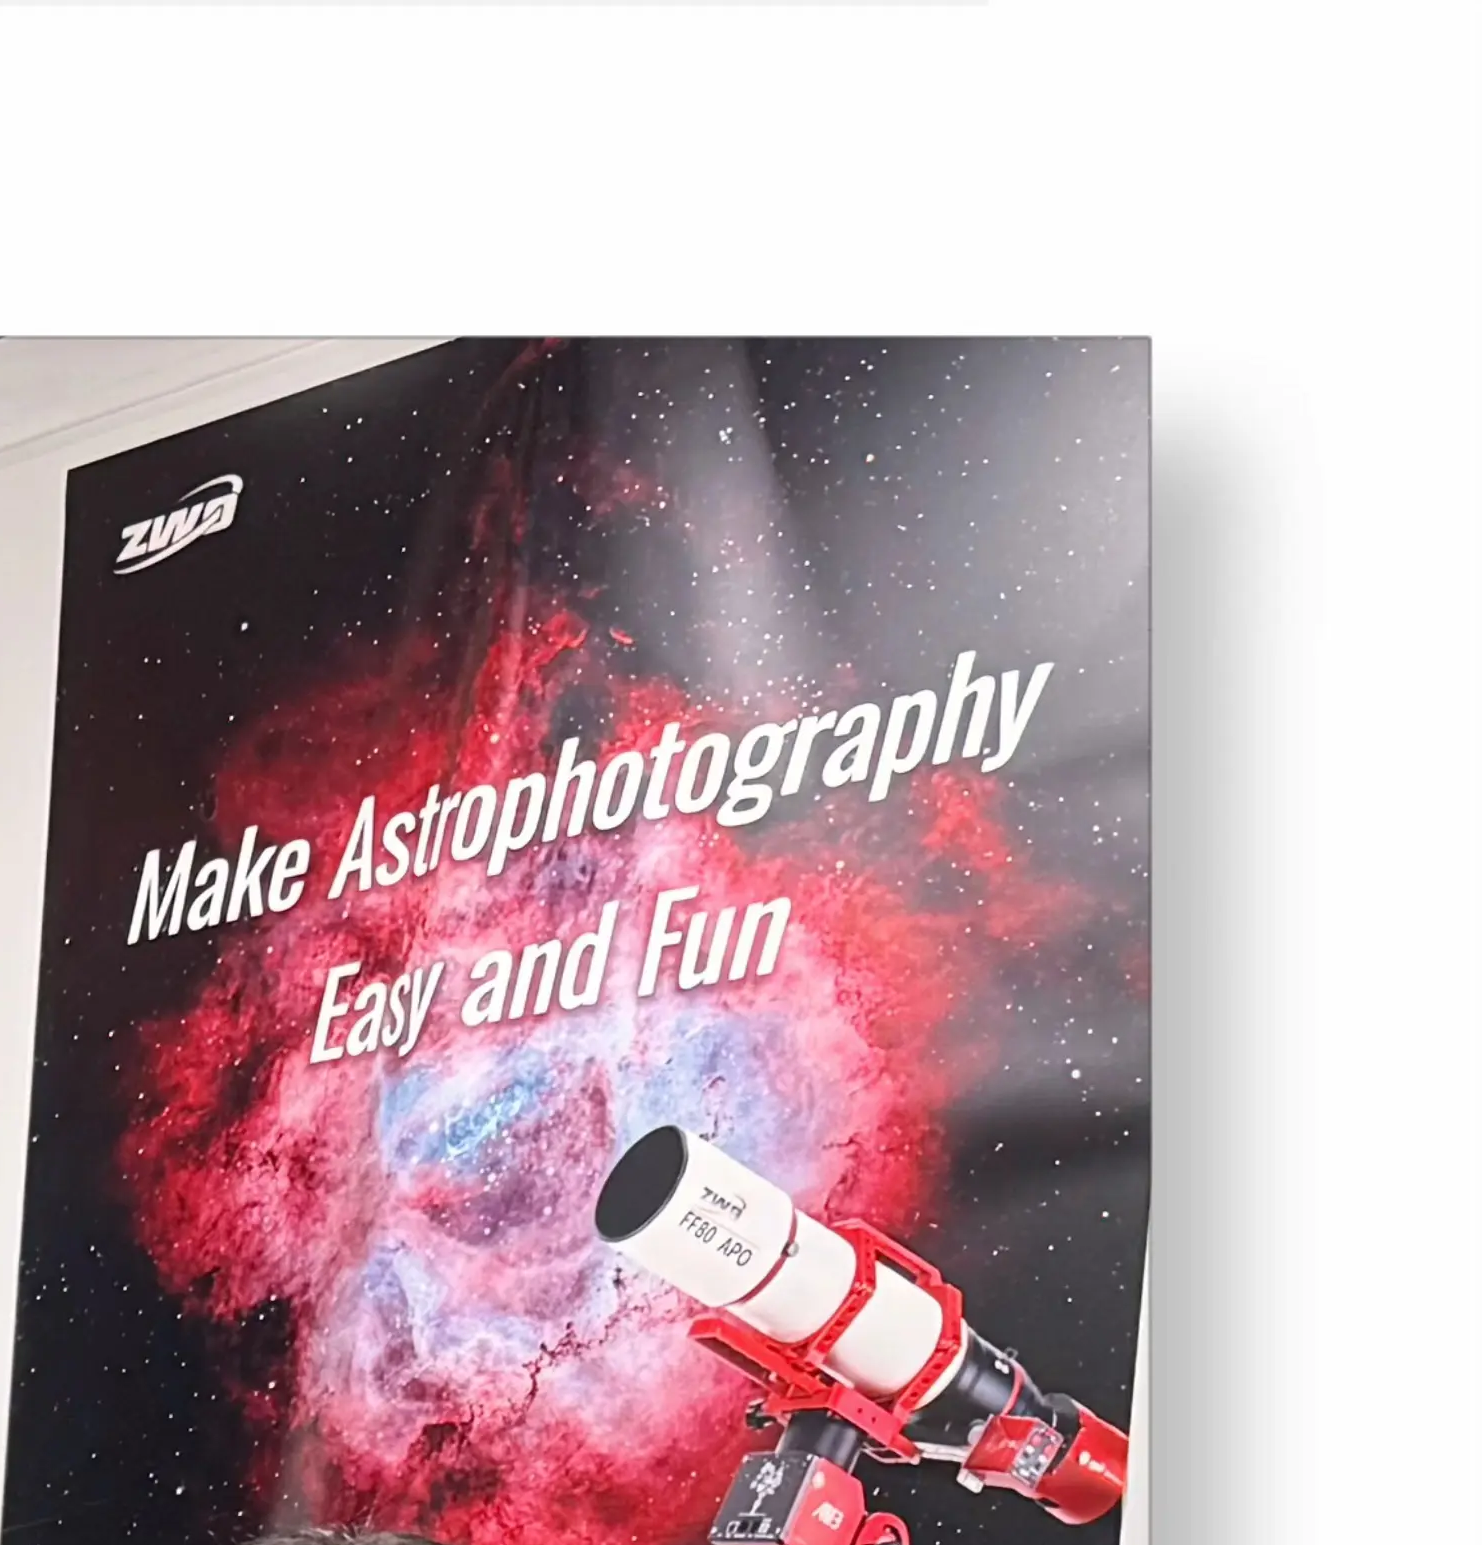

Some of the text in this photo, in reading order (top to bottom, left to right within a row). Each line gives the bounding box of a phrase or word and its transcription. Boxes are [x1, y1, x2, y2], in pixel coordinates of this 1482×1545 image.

[128, 650, 1053, 946] Make Astrophotography
[309, 886, 792, 1064] Easy and Fun
[679, 1211, 752, 1266] FF80 APO
